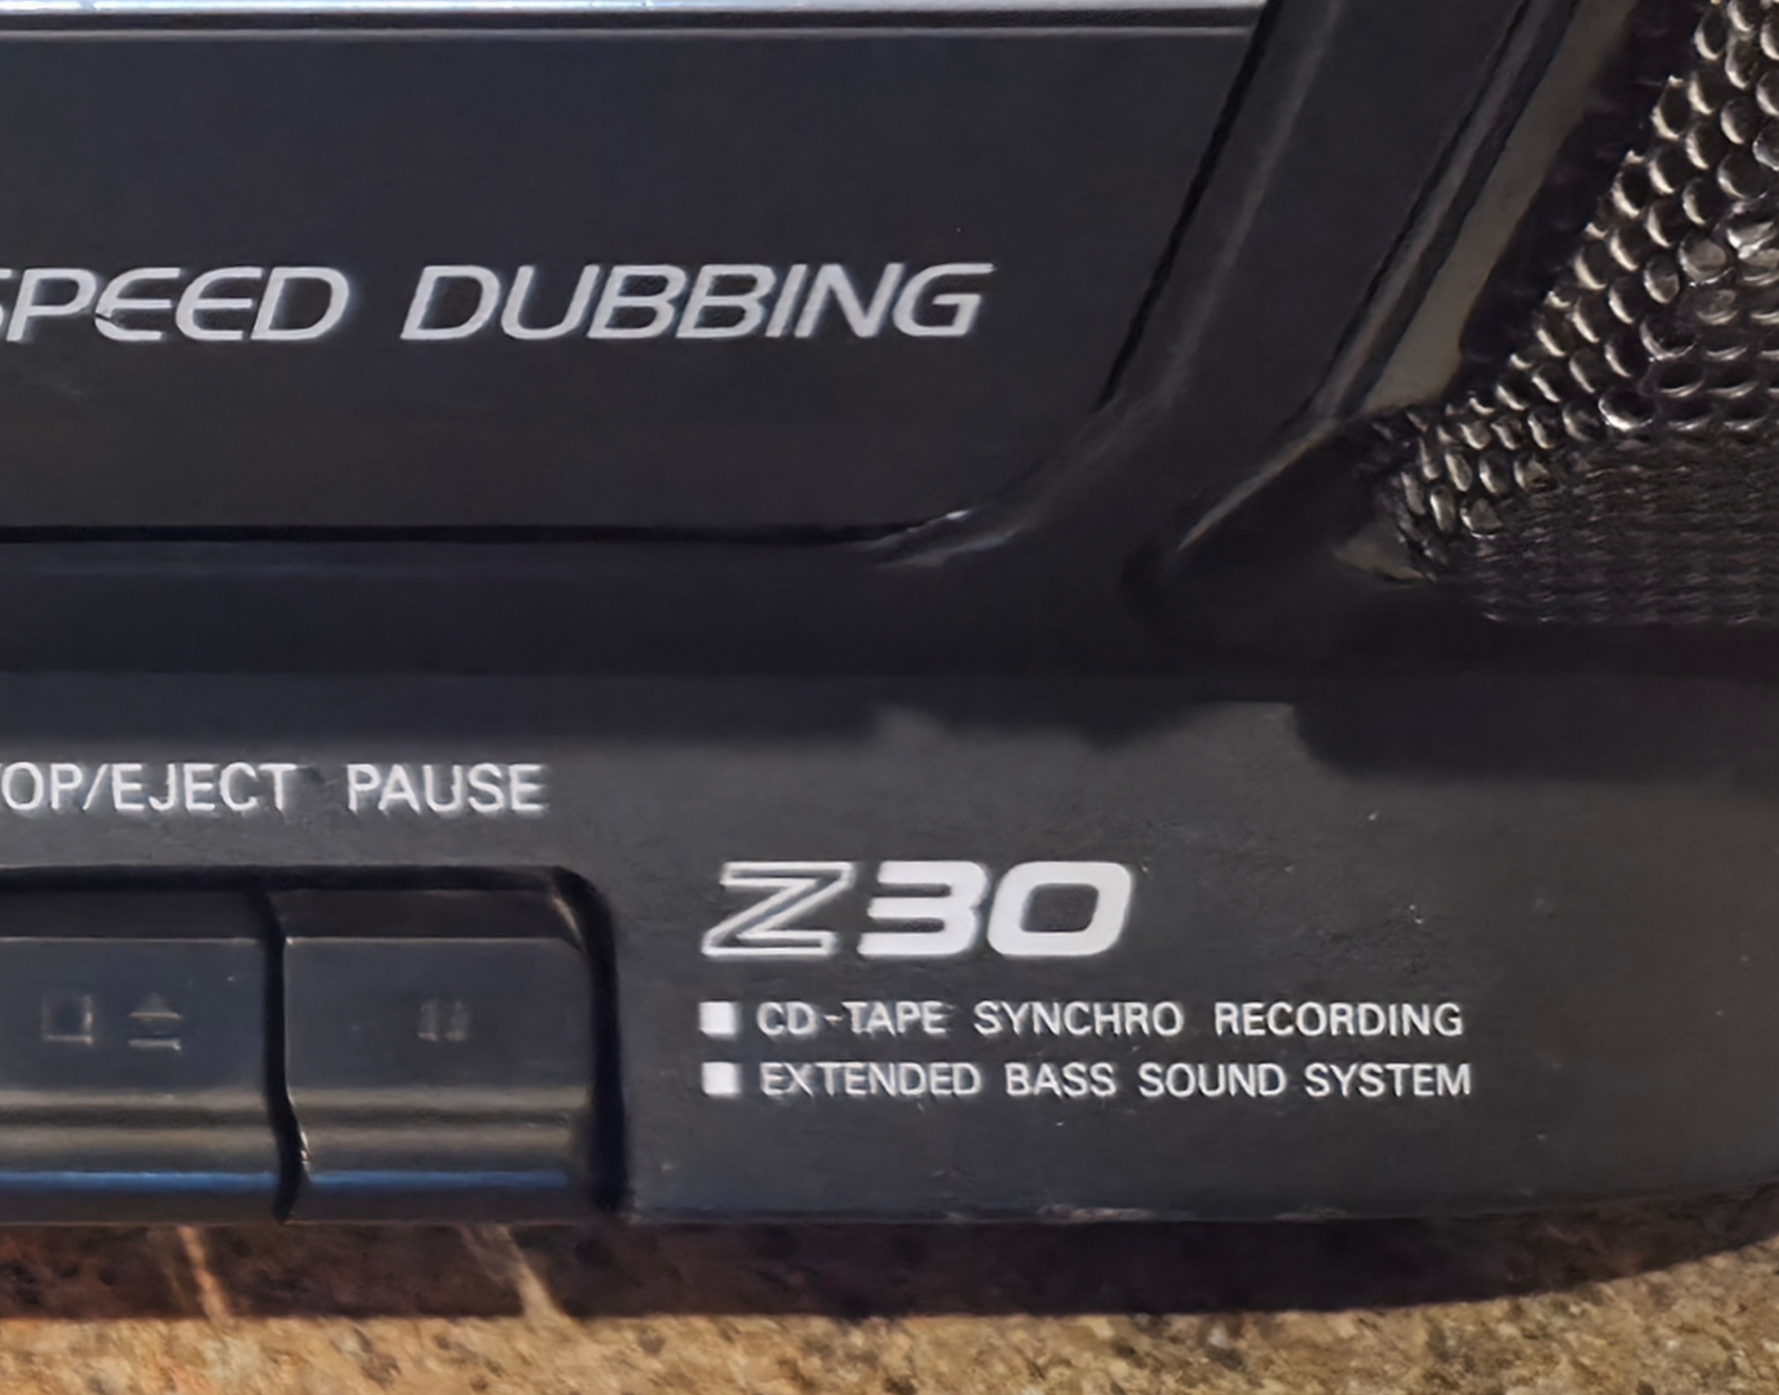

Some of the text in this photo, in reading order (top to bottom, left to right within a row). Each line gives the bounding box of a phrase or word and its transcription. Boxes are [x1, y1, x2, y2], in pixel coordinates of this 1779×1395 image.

[400, 262, 994, 341] DUBBING
[346, 762, 544, 814] PAUSE
[701, 860, 1133, 958] Z30
[756, 1000, 1463, 1037] CD-TAPE SYNCHRO RECORDING
[760, 1061, 1471, 1098] EXTENDED BASS SOUND SYSTEM
